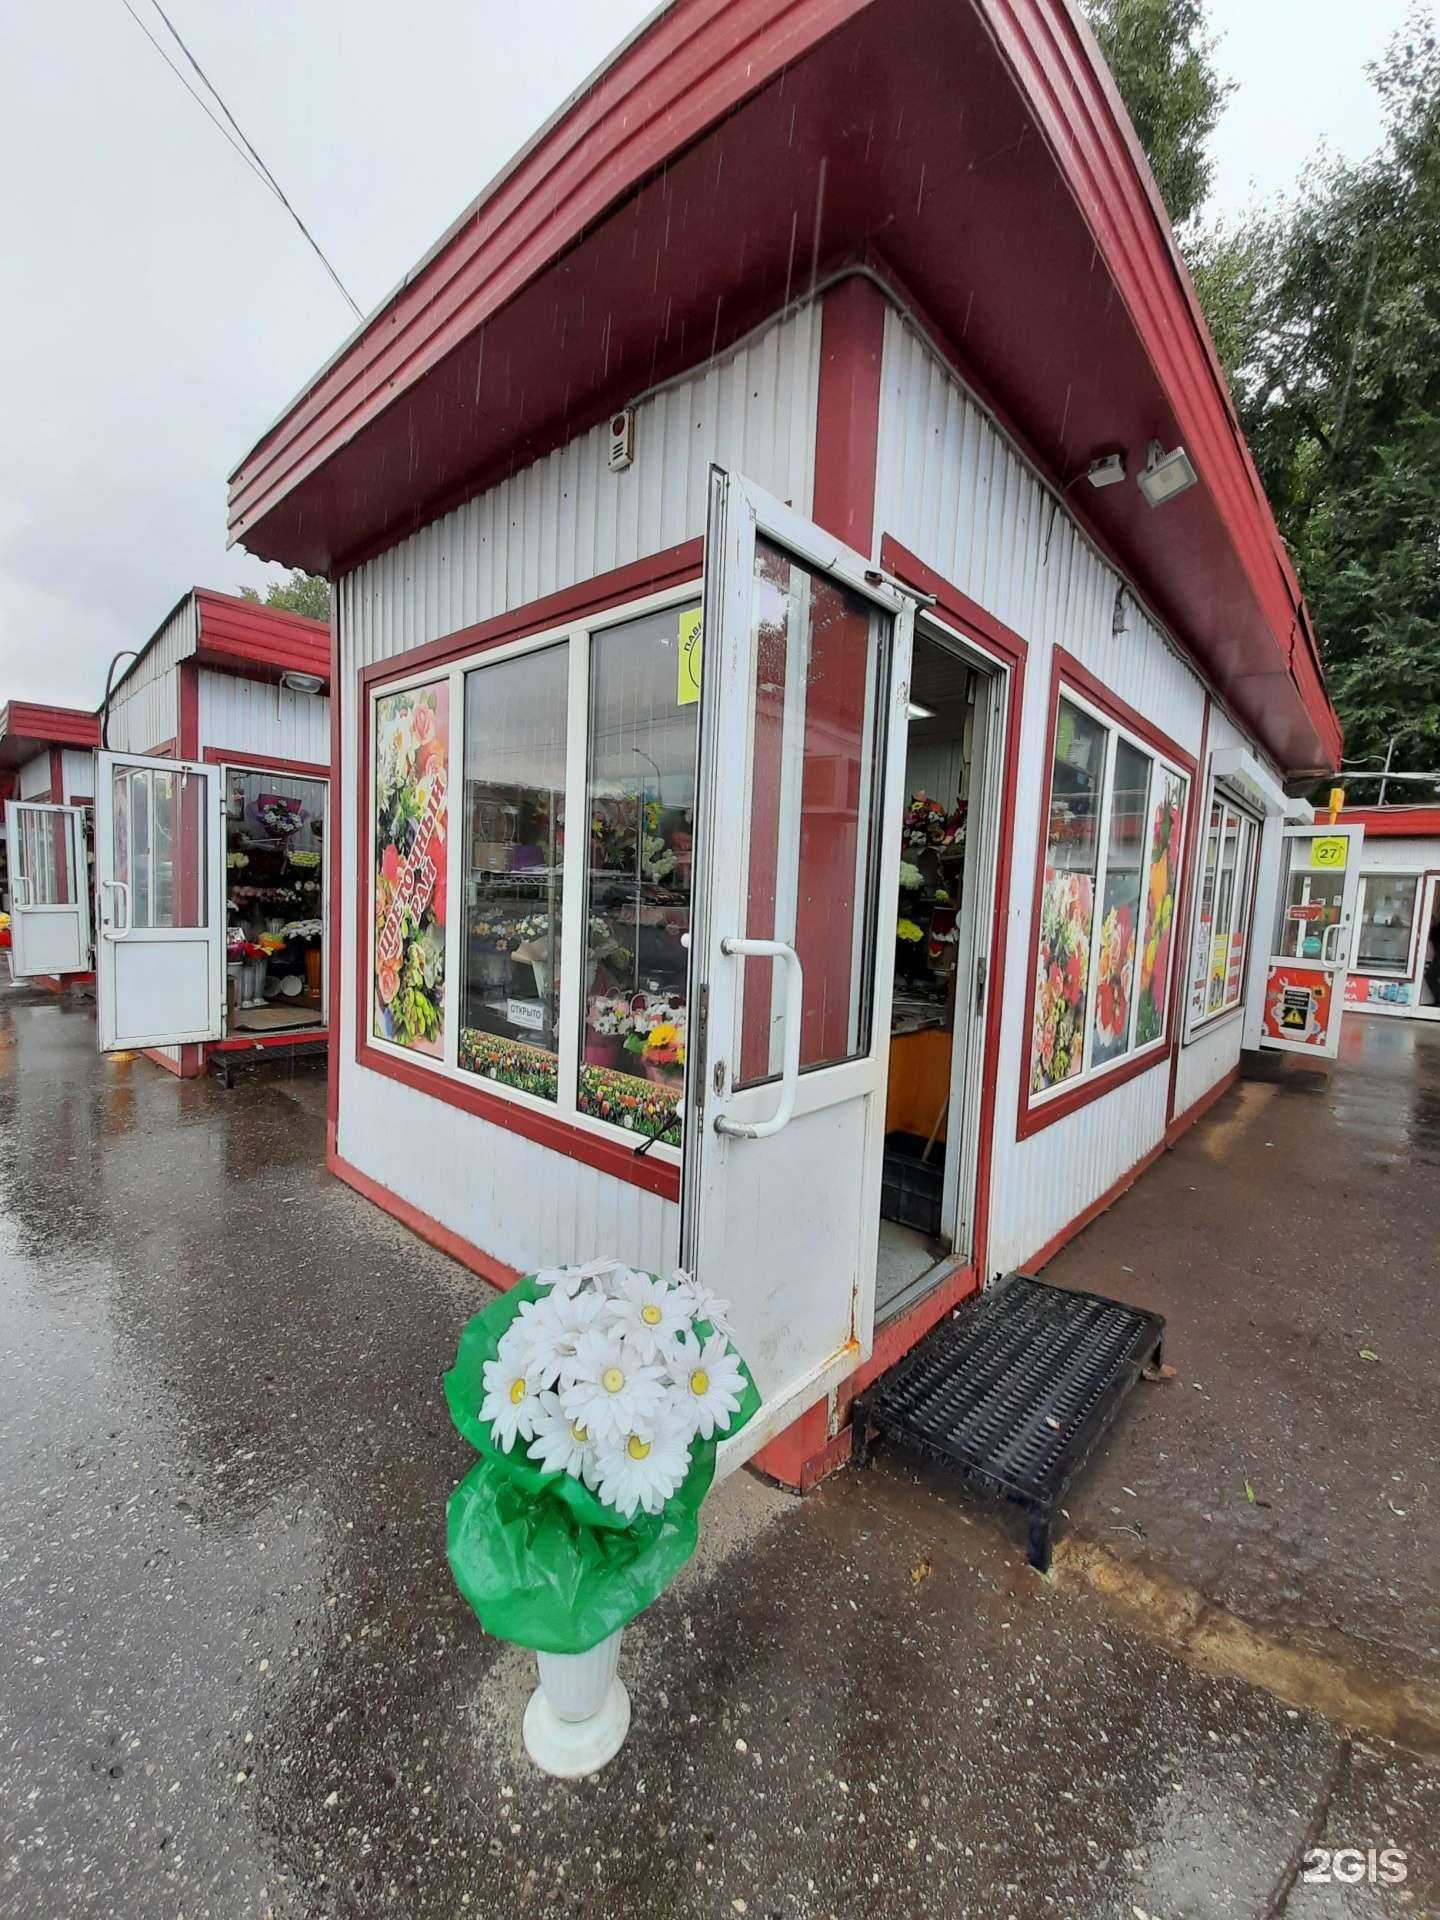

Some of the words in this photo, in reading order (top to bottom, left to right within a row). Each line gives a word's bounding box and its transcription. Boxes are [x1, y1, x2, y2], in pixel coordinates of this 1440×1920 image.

[378, 772, 447, 961] ЦВЕТОЧНЫЙ
[1319, 848, 1337, 859] 27
[410, 855, 437, 927] РАЙ
[511, 1004, 542, 1020] ОТКРЫТО
